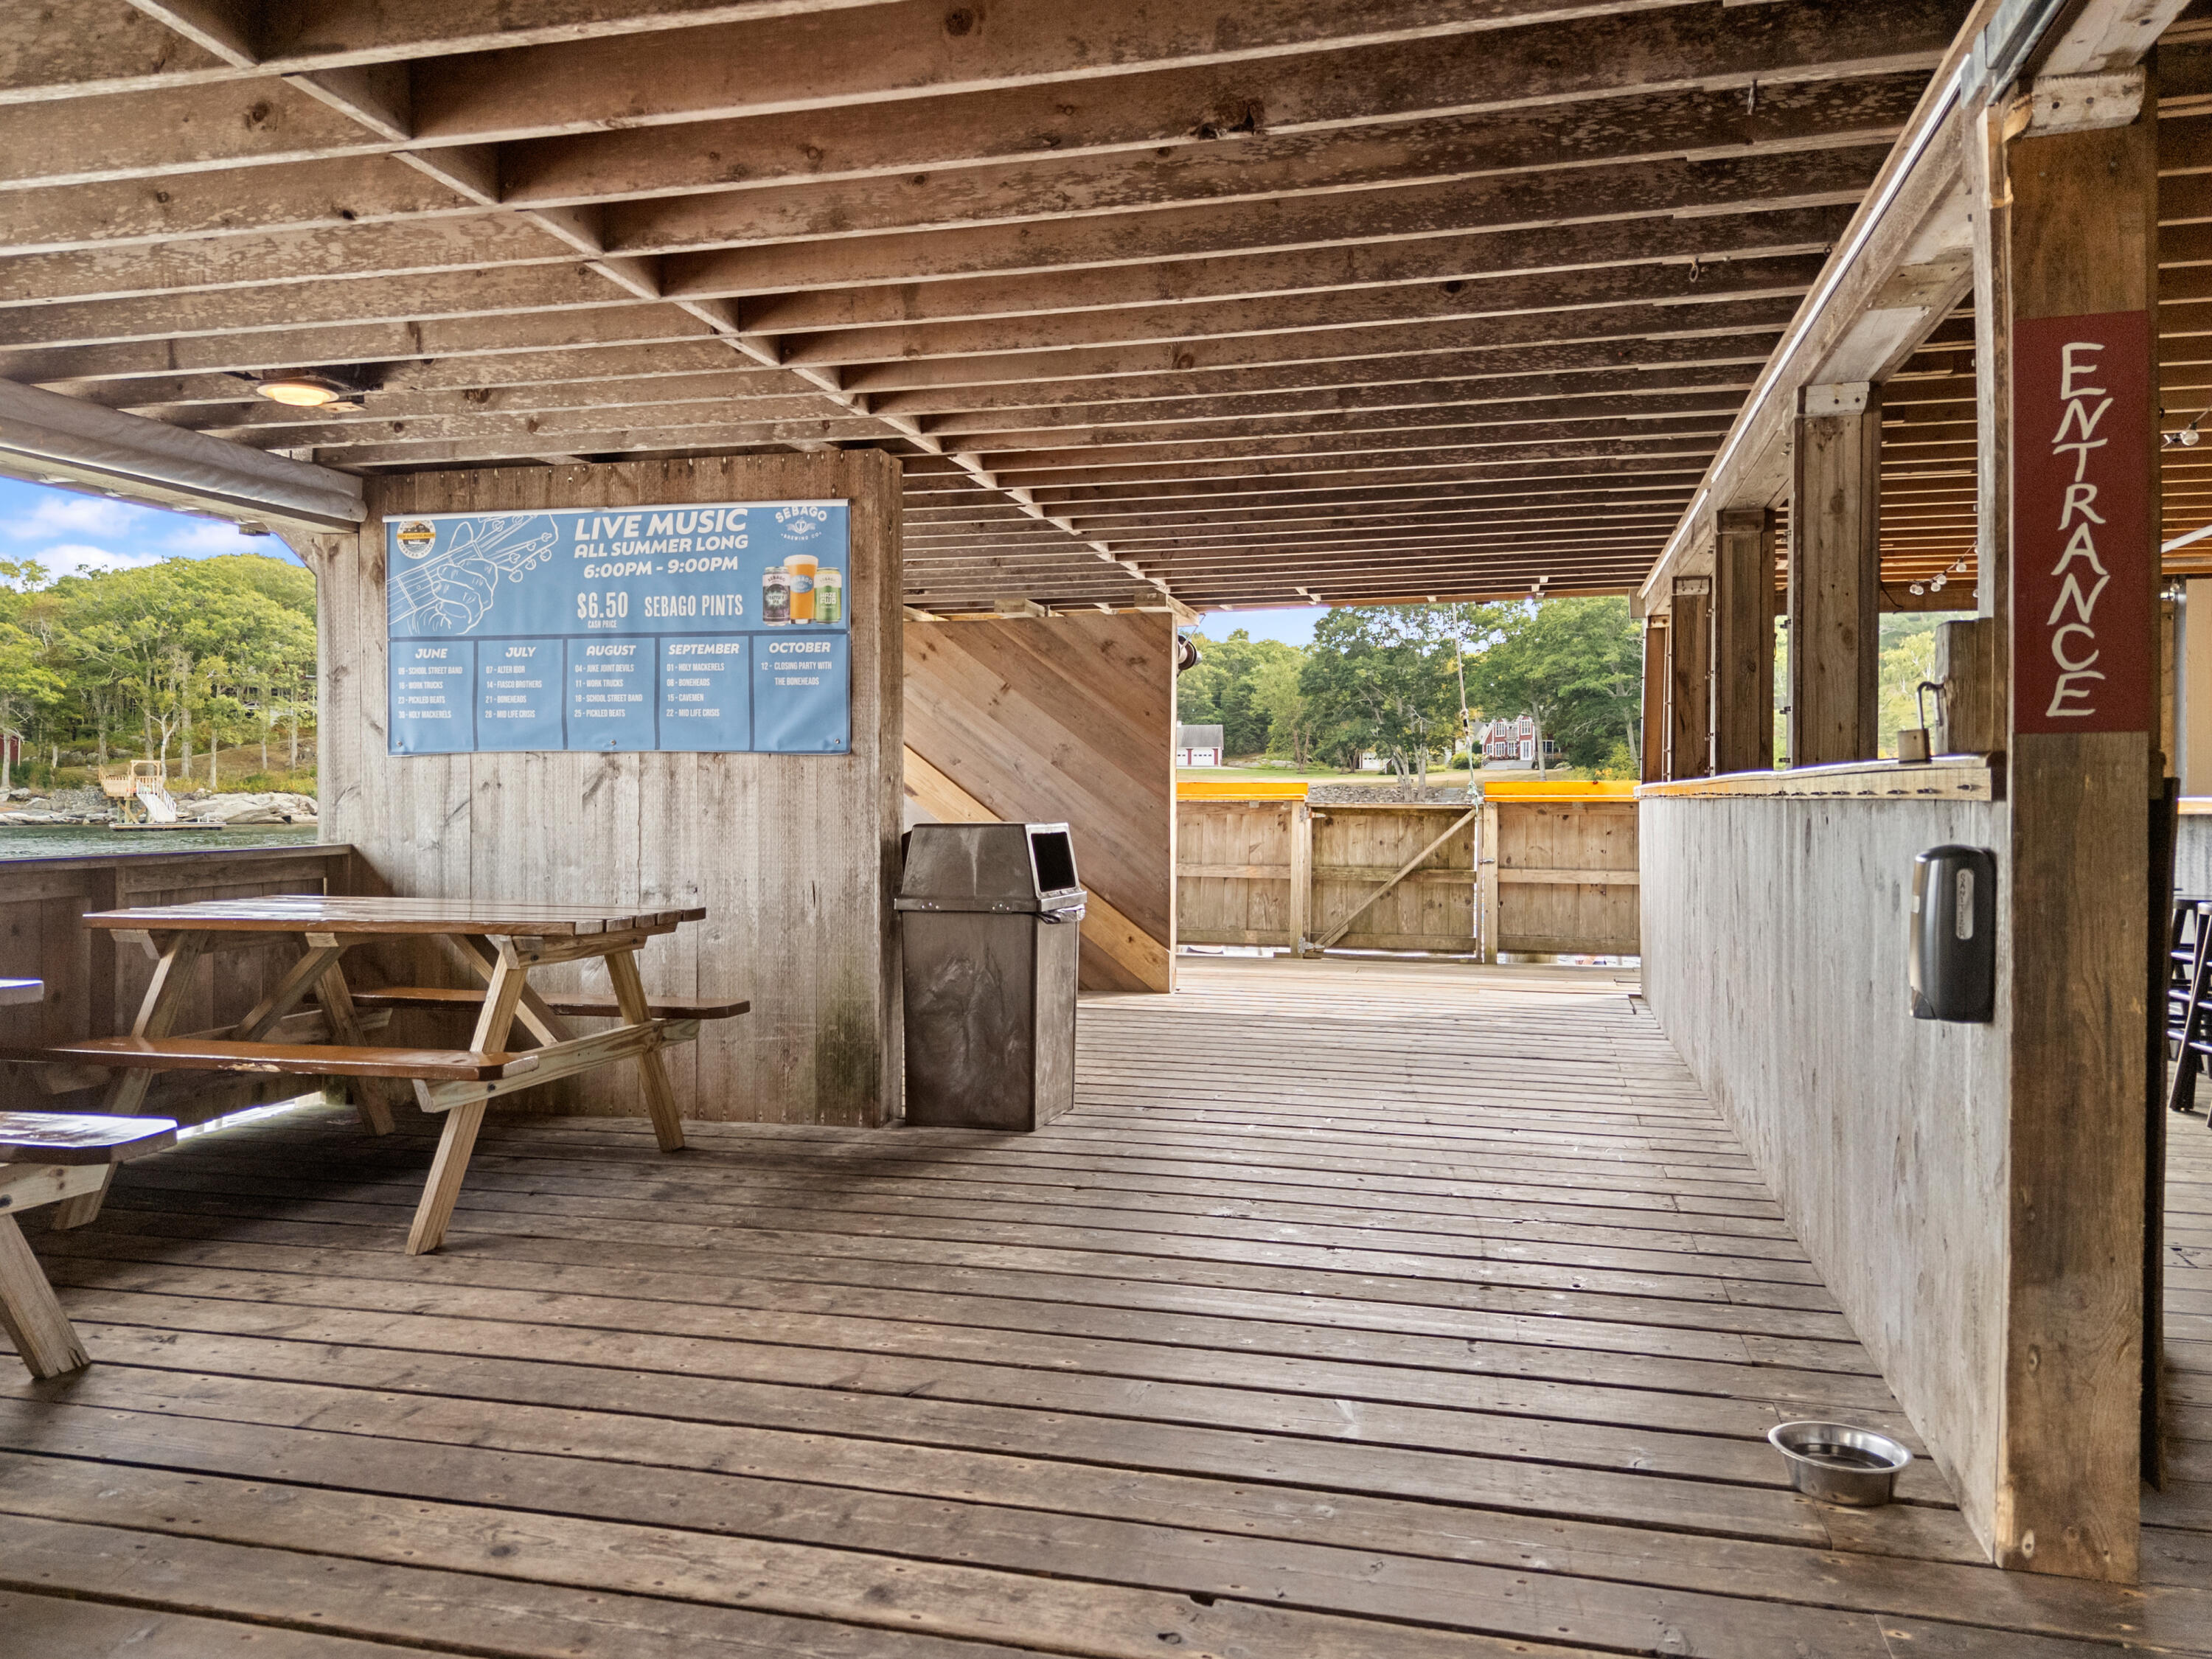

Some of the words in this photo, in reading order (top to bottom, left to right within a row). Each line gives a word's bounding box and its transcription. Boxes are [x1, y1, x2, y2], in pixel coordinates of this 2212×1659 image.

[776, 507, 827, 523] SEBAGO
[574, 515, 642, 541] LIVE
[646, 508, 748, 537] MUSIC
[2045, 341, 2114, 717] ENTRANCE
[574, 543, 608, 558] ALL
[611, 538, 692, 557] SUMMER
[695, 535, 748, 552] LONG
[584, 561, 652, 579] 6:00PM
[667, 556, 738, 574] 9:00PM
[577, 591, 628, 619] $6.50
[644, 595, 696, 617] SEBAGO
[701, 594, 743, 616] PINTS
[588, 620, 601, 628] CASH
[602, 620, 617, 628] PRICE
[586, 644, 636, 656] AUGUST
[668, 643, 740, 655] SEPTEMBER
[768, 642, 831, 653] OCTOBER
[415, 648, 448, 658] JUNE
[506, 647, 537, 658] JULY
[486, 666, 493, 674] 07
[587, 664, 599, 672] JUKE
[600, 664, 615, 672] JOINT
[616, 664, 634, 672] DEVILS
[667, 664, 674, 672] 01
[678, 663, 691, 671] HOLY
[761, 662, 768, 670] 12
[774, 661, 798, 670] CLOSING
[799, 661, 816, 669] PARTY
[818, 661, 832, 669] WITH
[408, 667, 427, 675] SCHOOL
[448, 666, 462, 674] BAND
[515, 680, 542, 688] BROTHERS
[586, 679, 602, 687] WORK
[603, 679, 623, 687] TRUCKS
[667, 678, 674, 686] 08
[678, 678, 710, 686] BONEHEADS
[775, 677, 785, 686] THE
[787, 677, 819, 686] BONEHEADS
[430, 695, 445, 703] BEATS
[485, 695, 493, 703] 21
[497, 695, 526, 703] BONEHEADS
[607, 694, 627, 702] STREET
[628, 694, 643, 702] BAND
[667, 694, 674, 702] 15
[678, 693, 704, 701] CAVEMEN
[497, 710, 507, 718] MID
[507, 710, 518, 718] LIFE
[519, 709, 535, 717] CRISIS
[574, 709, 582, 717] 25
[586, 709, 608, 717] PICKLED
[609, 709, 625, 717] BEATS
[678, 709, 689, 717] MID
[690, 709, 701, 717] LIFE
[702, 709, 720, 717] CRISIS
